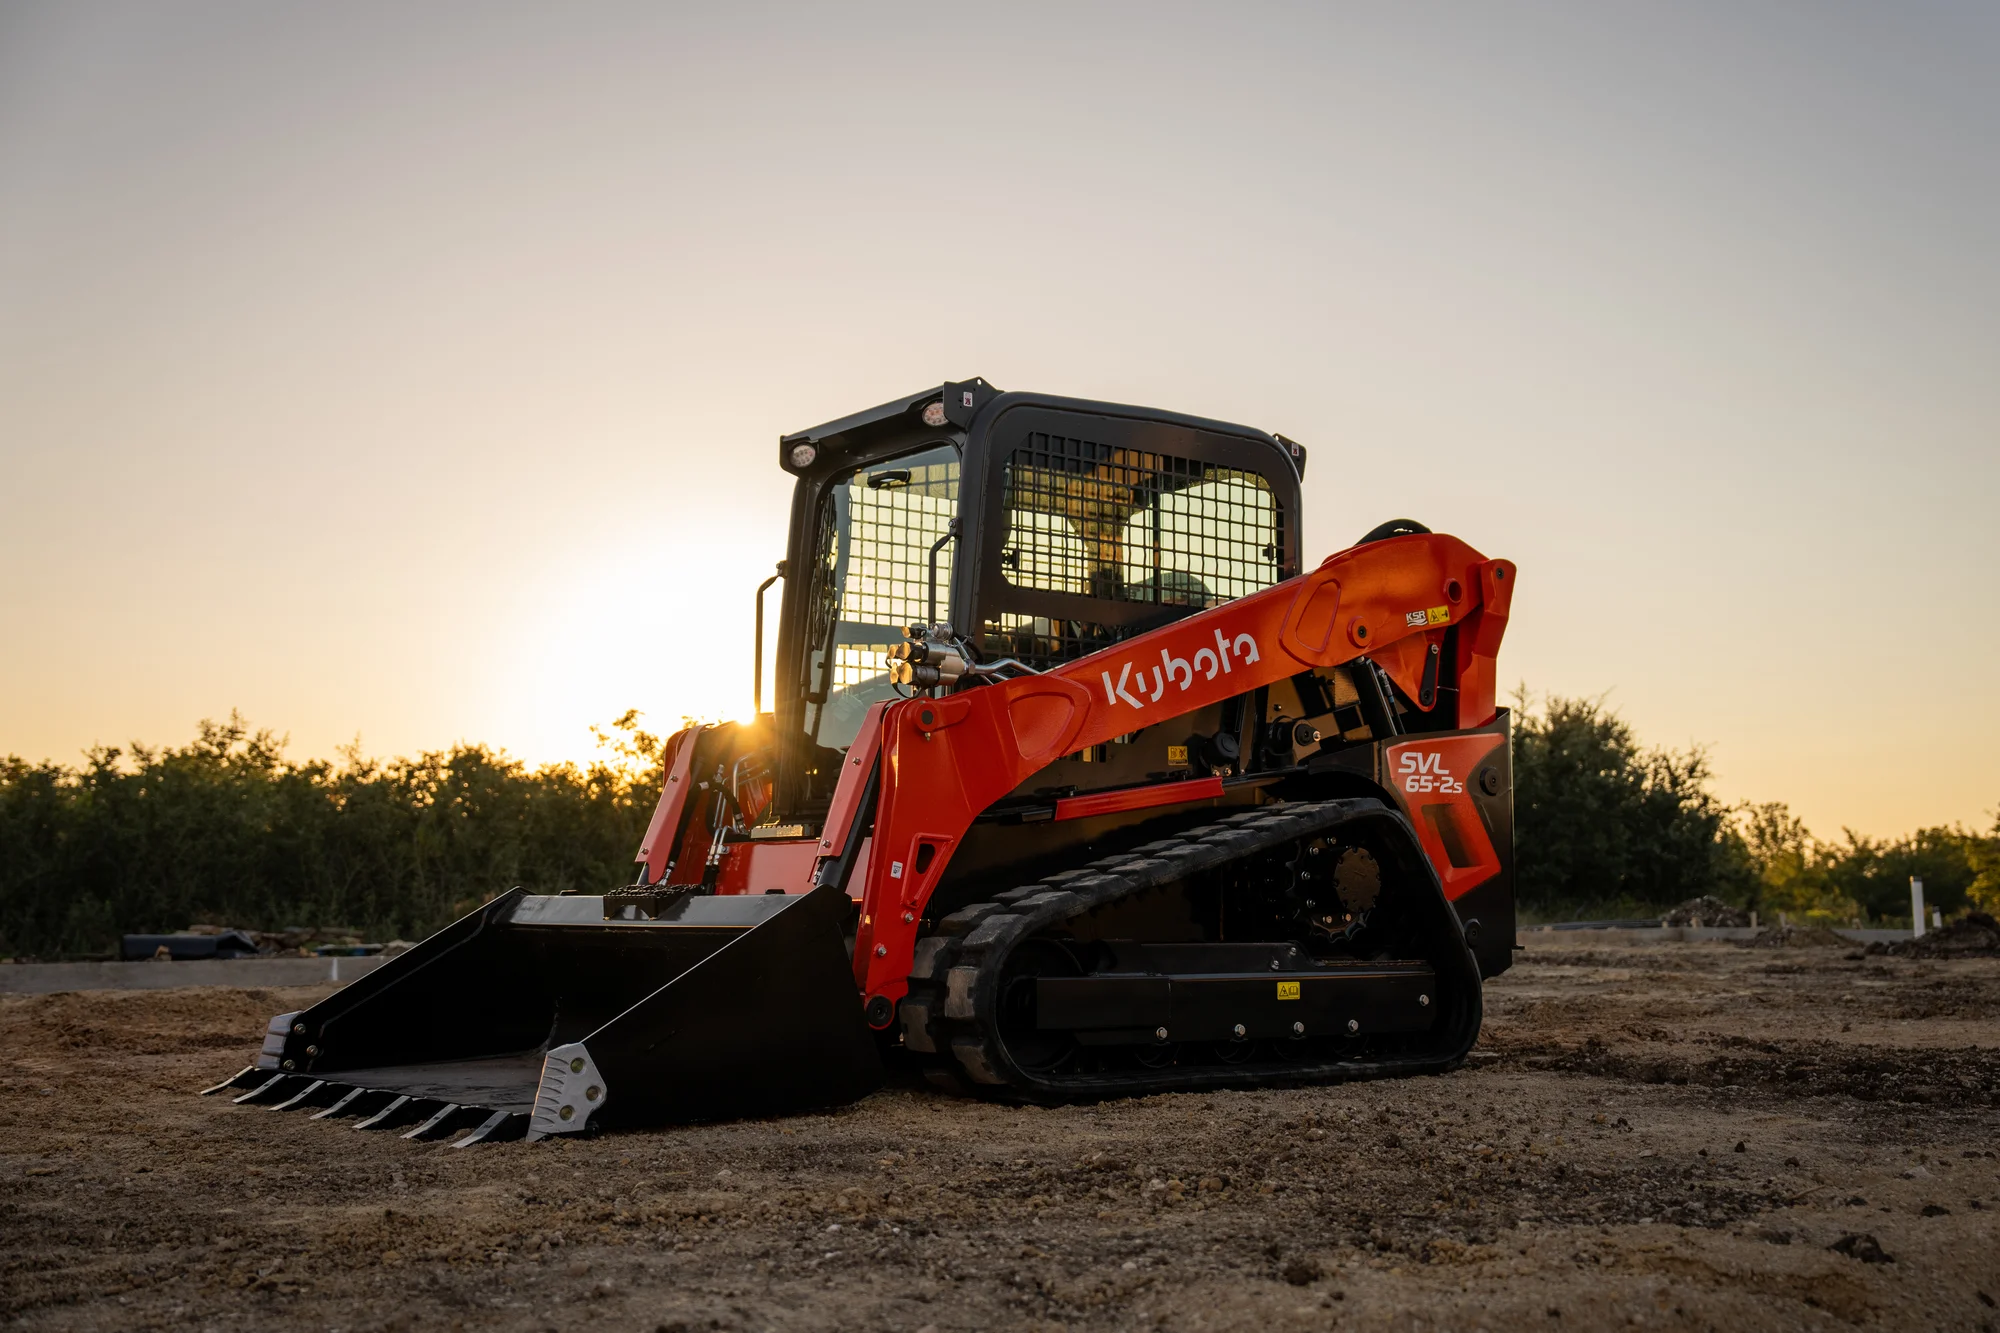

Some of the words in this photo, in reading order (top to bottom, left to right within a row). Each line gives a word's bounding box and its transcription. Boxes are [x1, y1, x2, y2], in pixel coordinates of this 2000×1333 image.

[1406, 610, 1425, 622] KSR
[1101, 628, 1260, 709] Kubota
[1398, 752, 1449, 774] SVL
[1405, 775, 1463, 793] 65-2s
